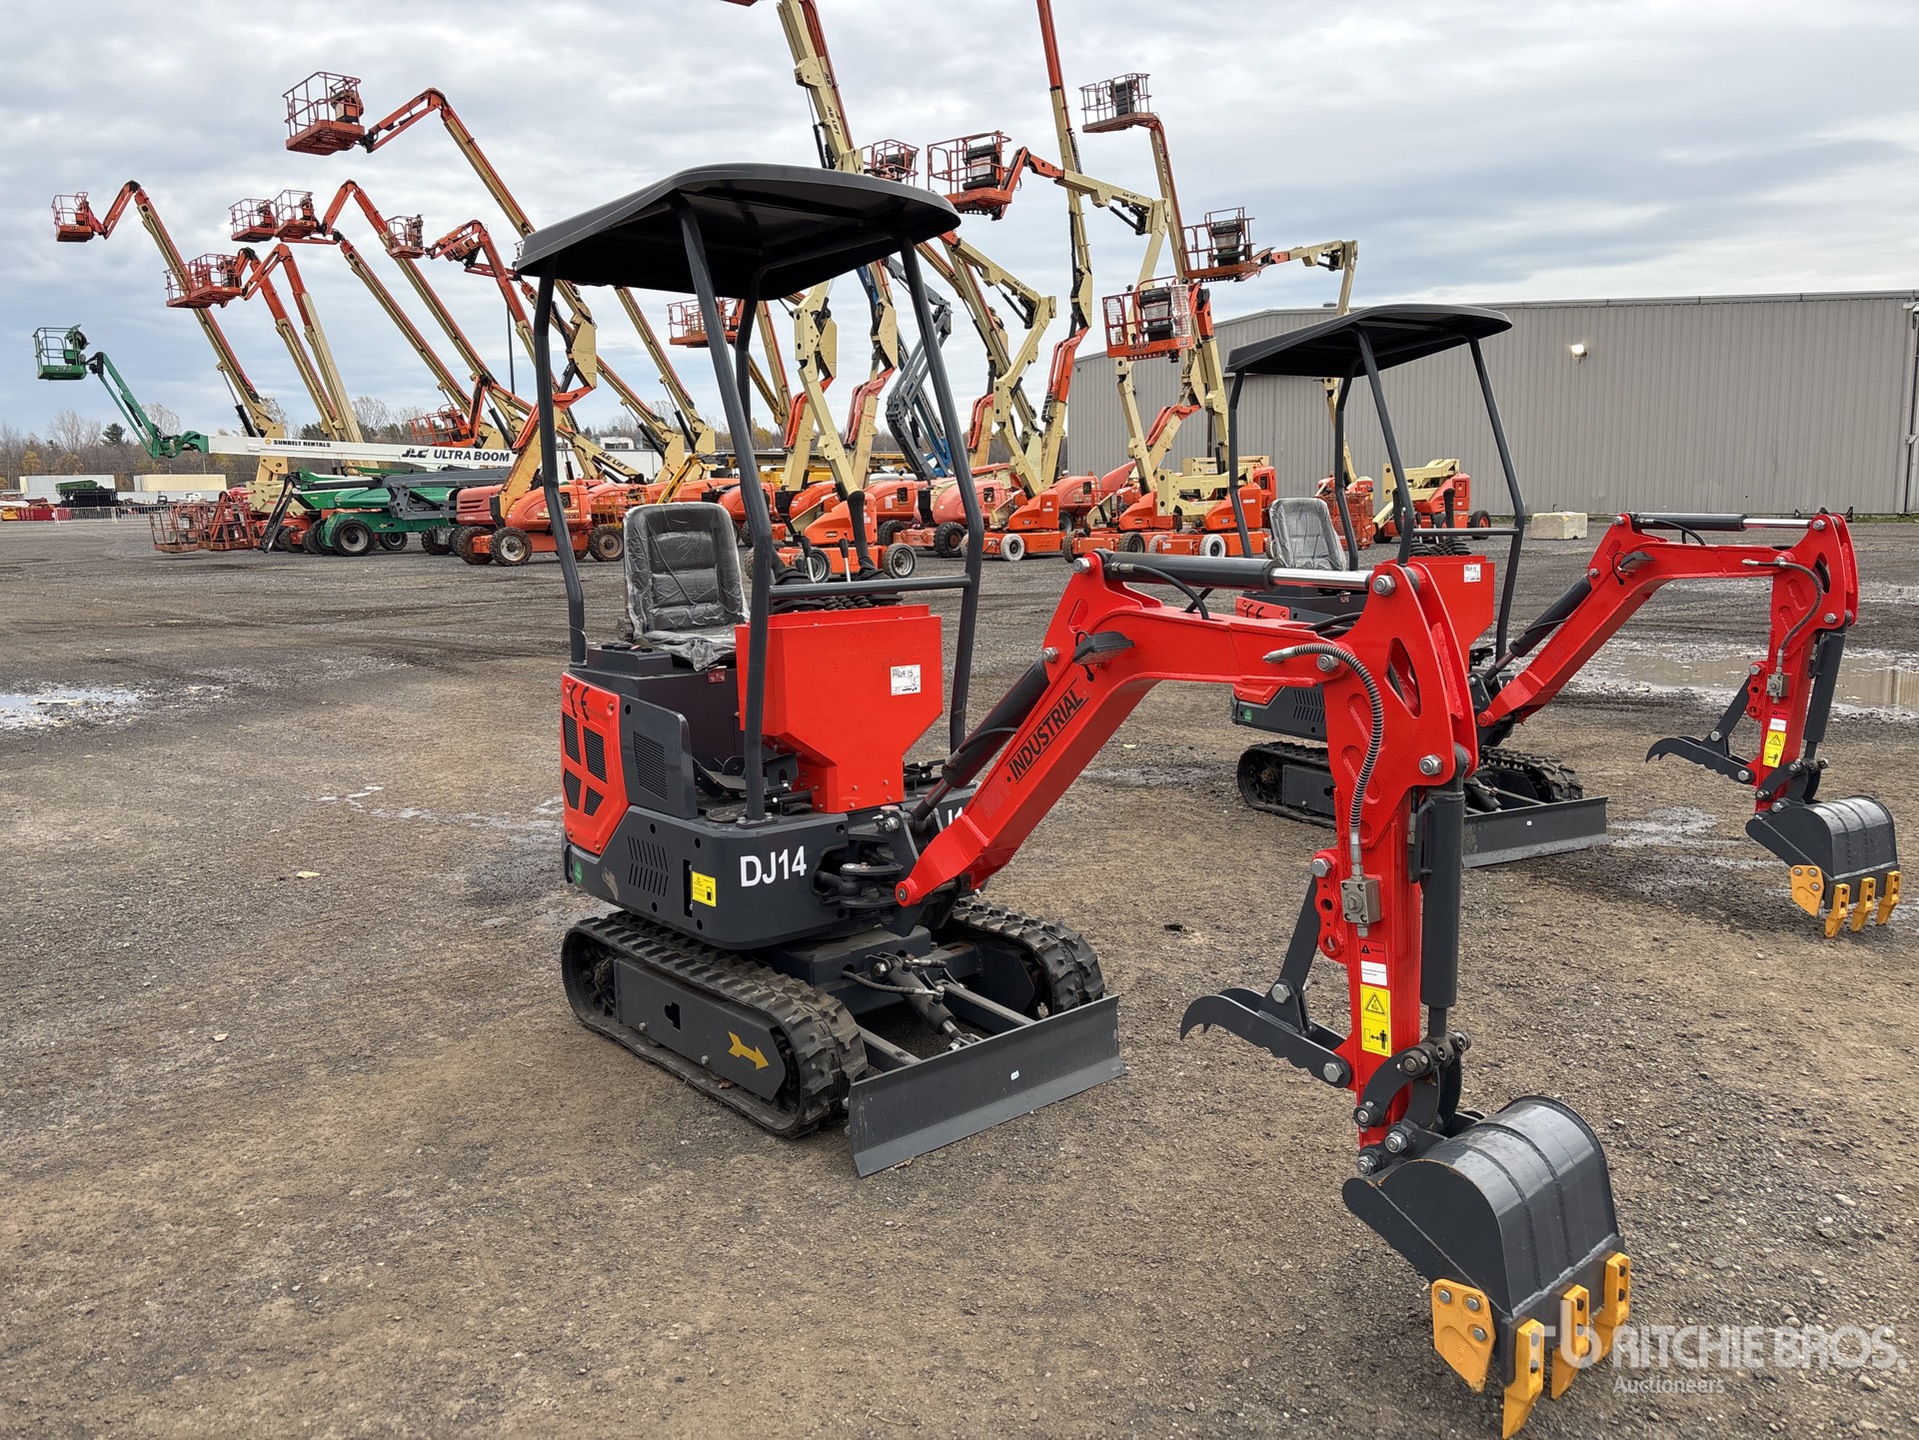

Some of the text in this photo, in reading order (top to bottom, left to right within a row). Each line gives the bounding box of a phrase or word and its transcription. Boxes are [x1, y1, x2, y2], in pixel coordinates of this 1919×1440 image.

[273, 439, 331, 448] SUNBELT RENTALS
[401, 448, 510, 463] JLG ULTRA BOOM
[598, 451, 628, 471] JLG LIFT
[1009, 689, 1085, 781] INDUSTRIAL
[740, 845, 807, 888] DJ14
